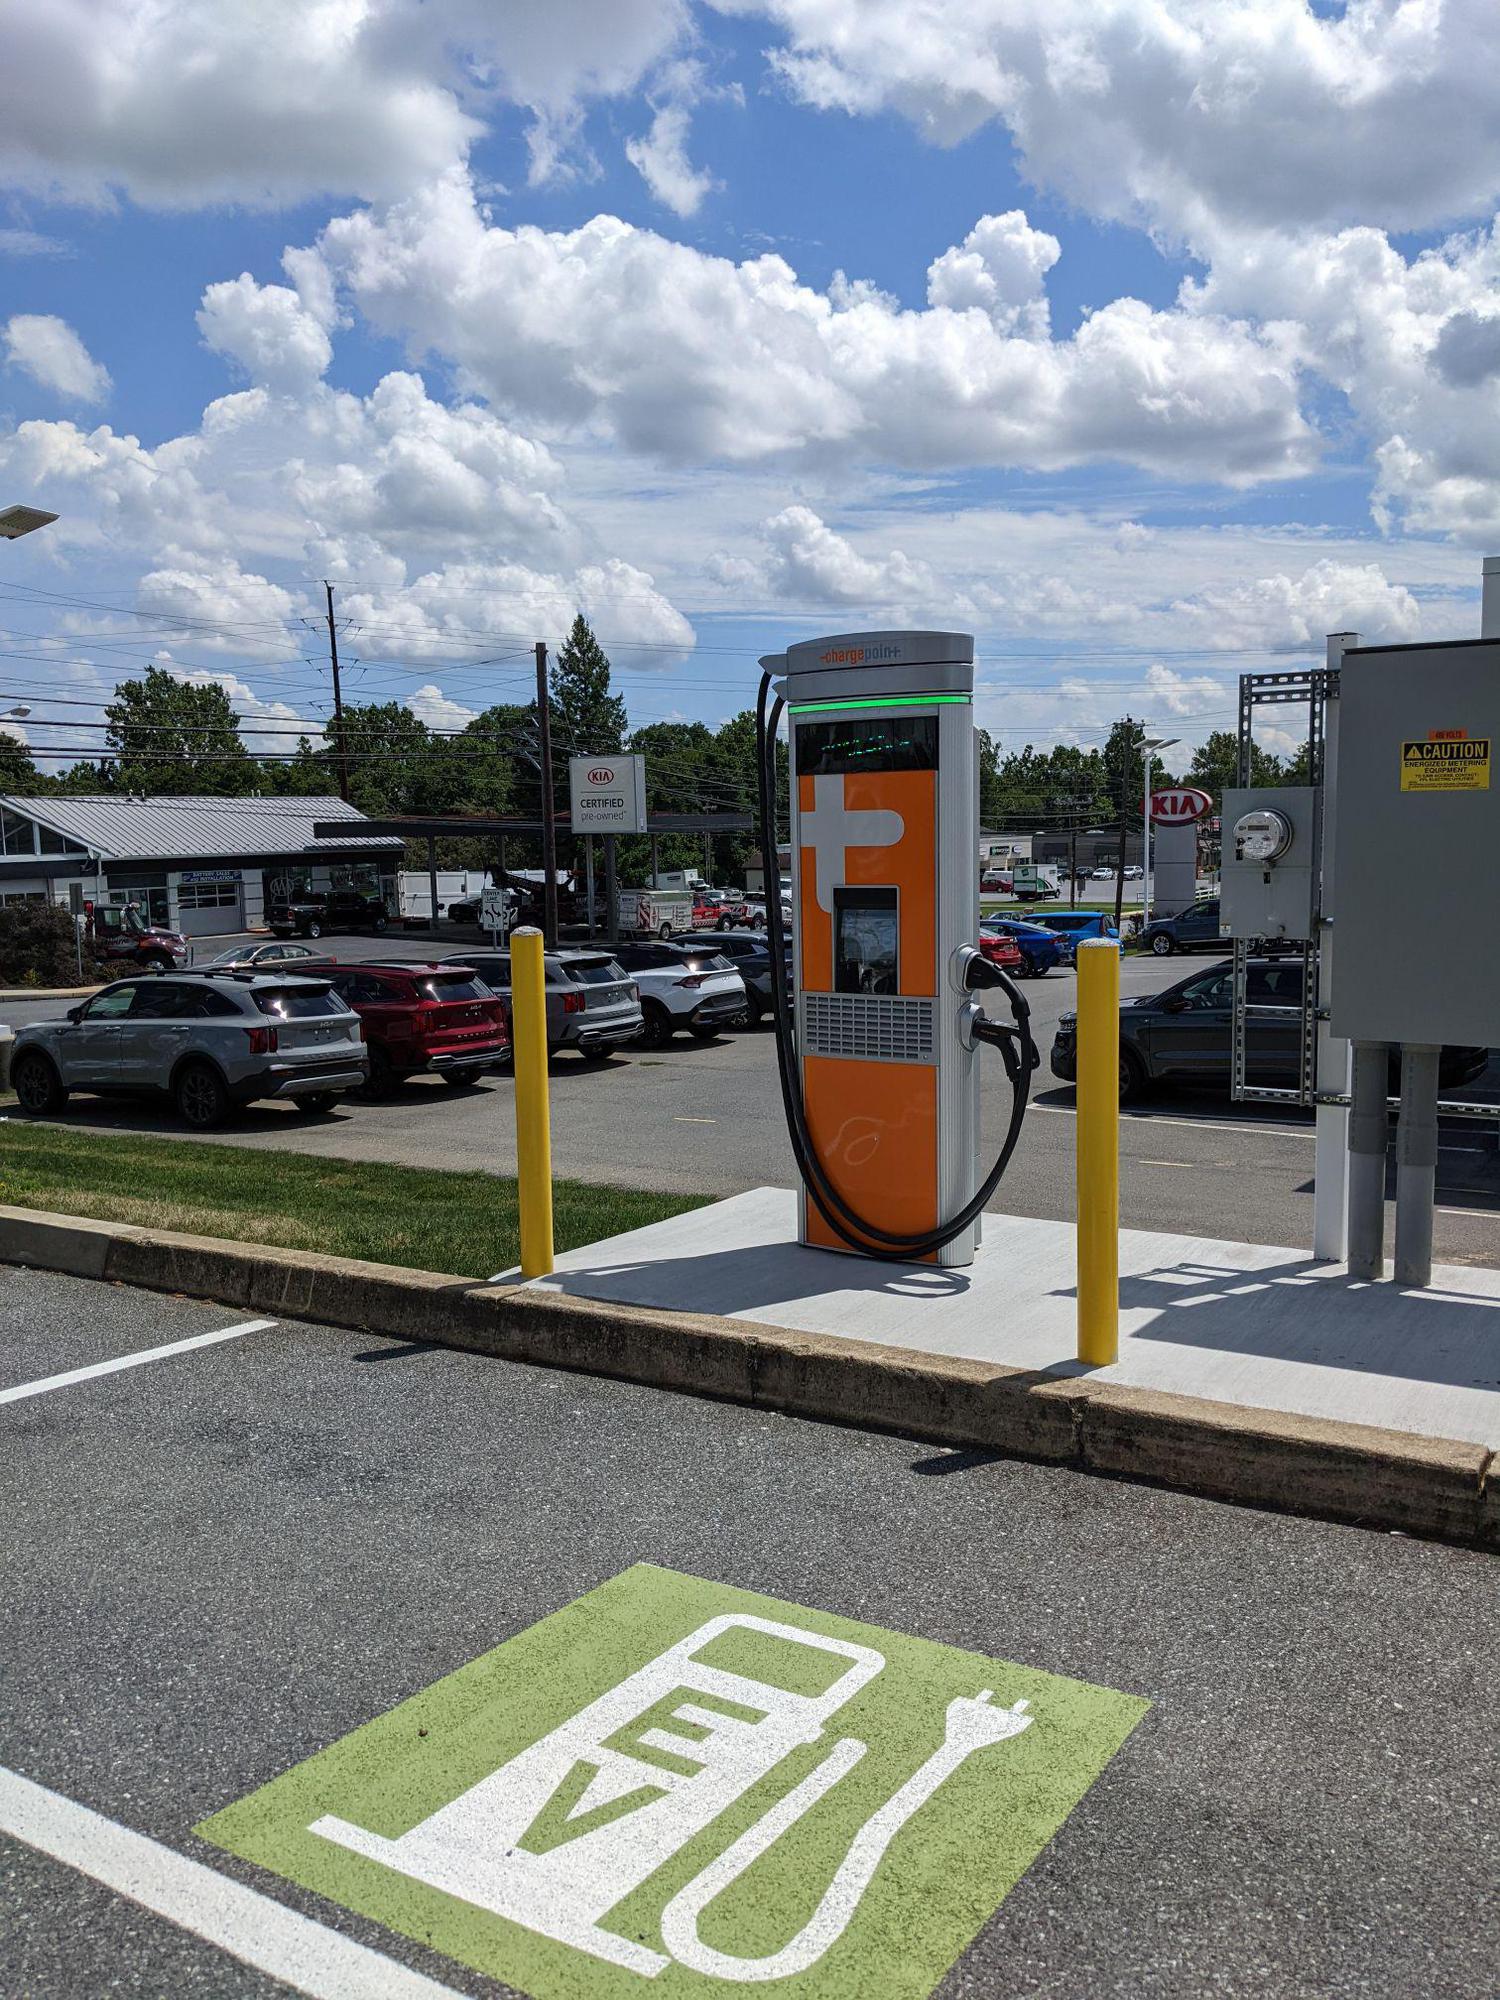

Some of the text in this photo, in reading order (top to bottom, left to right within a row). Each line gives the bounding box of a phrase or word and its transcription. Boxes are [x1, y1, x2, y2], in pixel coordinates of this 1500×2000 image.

[1423, 743, 1484, 759] CAUTION
[1404, 759, 1487, 768] ENERGIZED METERING
[592, 771, 610, 782] KIA
[580, 798, 625, 808] CERTIFIED
[1151, 795, 1198, 815] KIA
